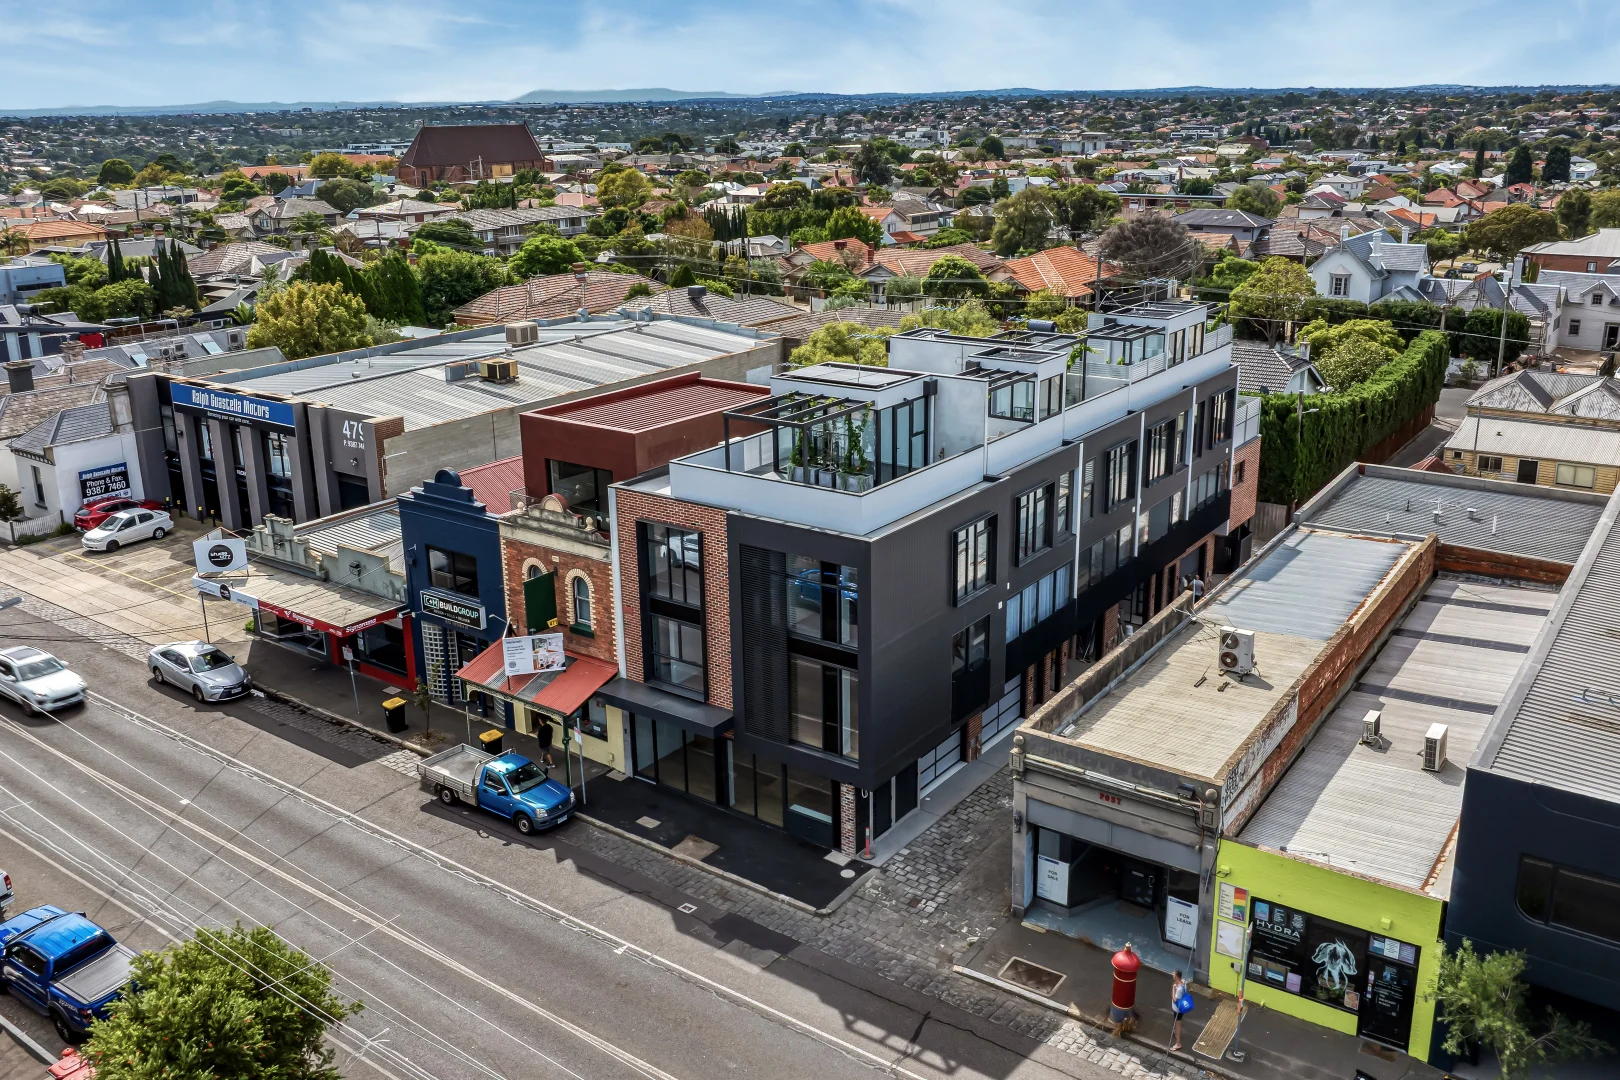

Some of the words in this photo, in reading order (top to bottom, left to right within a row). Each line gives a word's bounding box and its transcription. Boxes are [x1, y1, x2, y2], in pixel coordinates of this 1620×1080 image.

[192, 389, 209, 408] Ralph
[210, 394, 242, 412] Guastella
[243, 400, 270, 418] Motors
[86, 479, 105, 488] Phone
[86, 485, 105, 497] 9387
[108, 480, 126, 491] 7460
[440, 601, 479, 618] BUILDGROUP
[1099, 792, 1122, 805] POST
[1047, 874, 1059, 882] SALE
[1176, 917, 1192, 926] LEASE
[1179, 912, 1190, 920] FOR
[1256, 919, 1301, 938] HYDRA
